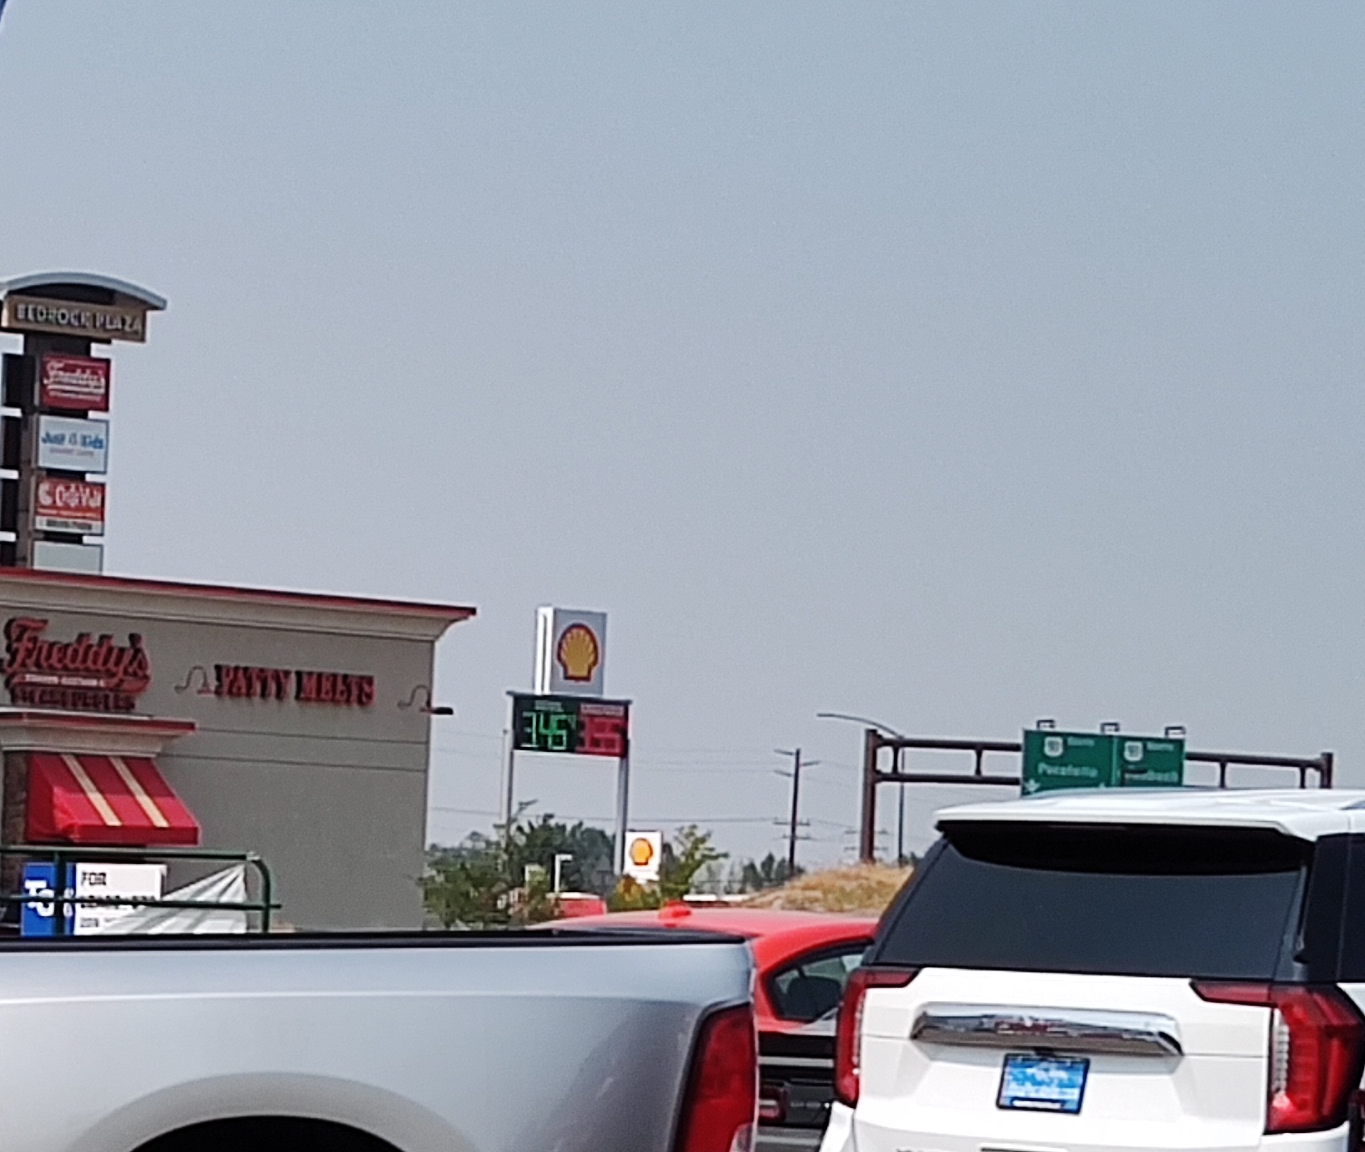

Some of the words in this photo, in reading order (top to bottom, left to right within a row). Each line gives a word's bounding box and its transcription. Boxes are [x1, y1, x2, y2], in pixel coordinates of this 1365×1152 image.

[16, 303, 91, 330] BEDROCK
[94, 312, 144, 337] PLAZA
[214, 664, 292, 701] PATTY
[295, 670, 375, 706] MELTS
[81, 871, 107, 886] FOR
